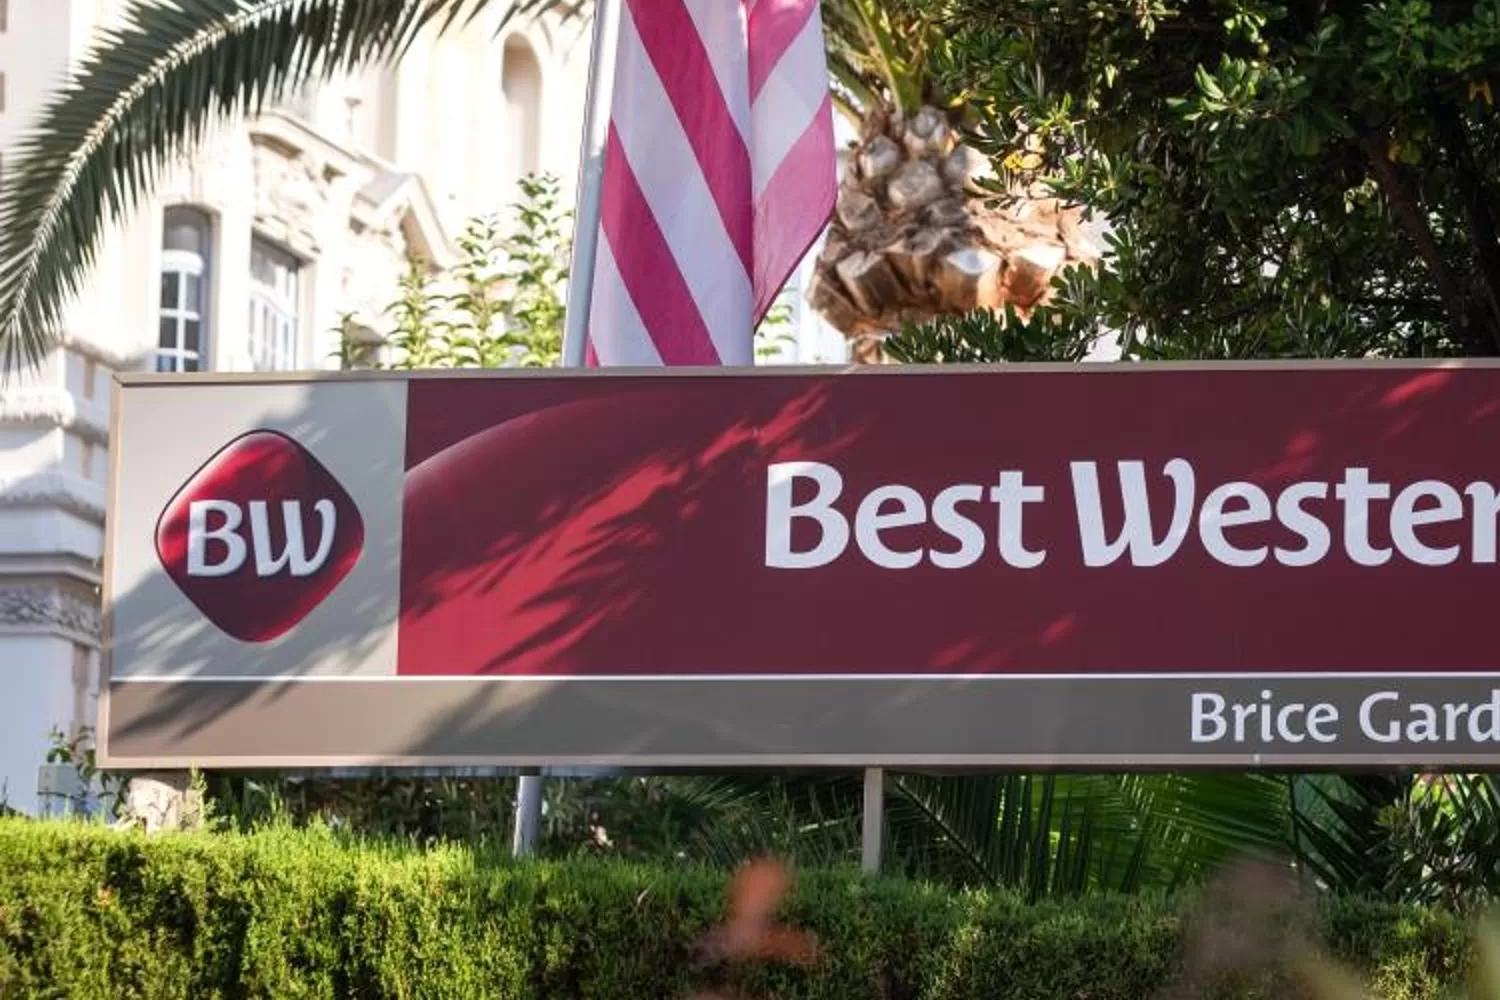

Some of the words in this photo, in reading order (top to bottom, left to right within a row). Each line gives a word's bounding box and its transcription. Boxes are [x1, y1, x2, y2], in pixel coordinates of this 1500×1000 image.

[186, 498, 337, 577] BW
[765, 461, 1046, 568] Best
[1190, 689, 1339, 743] Brice
